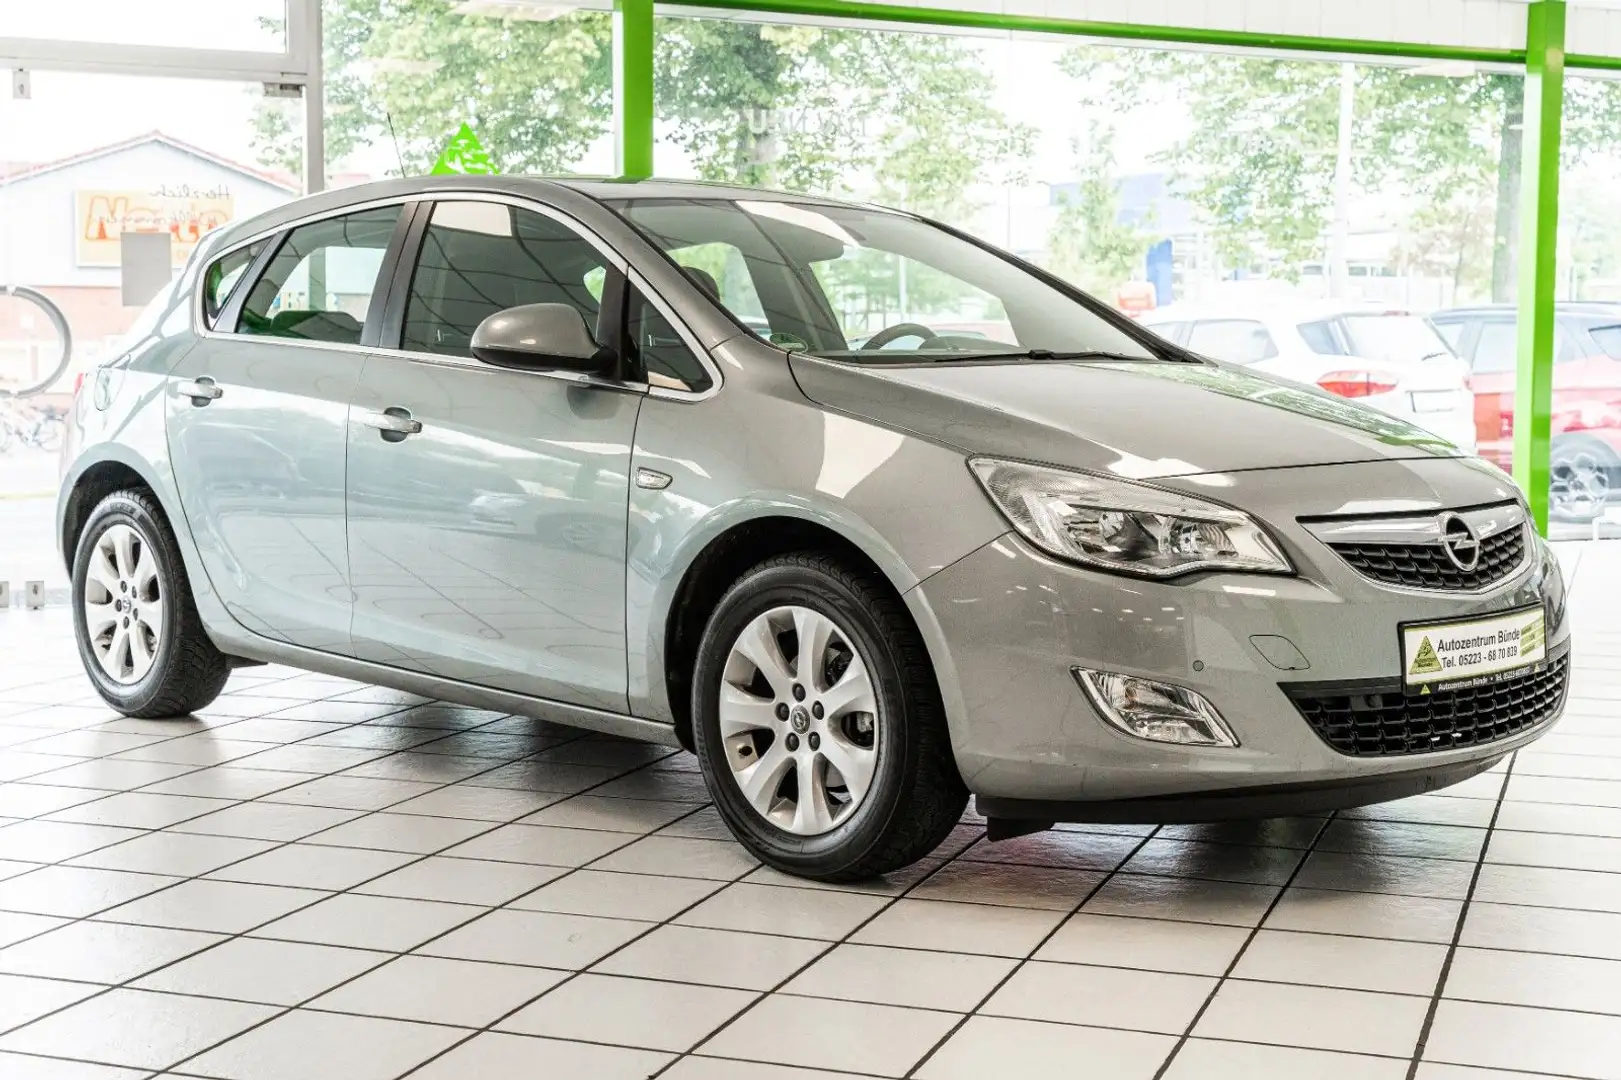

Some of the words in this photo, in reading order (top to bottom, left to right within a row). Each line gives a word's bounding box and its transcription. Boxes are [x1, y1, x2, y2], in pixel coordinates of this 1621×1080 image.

[1437, 634, 1496, 653] Autozentrum
[1498, 627, 1520, 644] Bünde
[1441, 656, 1457, 669] Tel.
[1458, 651, 1482, 666] 05223
[1488, 650, 1497, 662] 68
